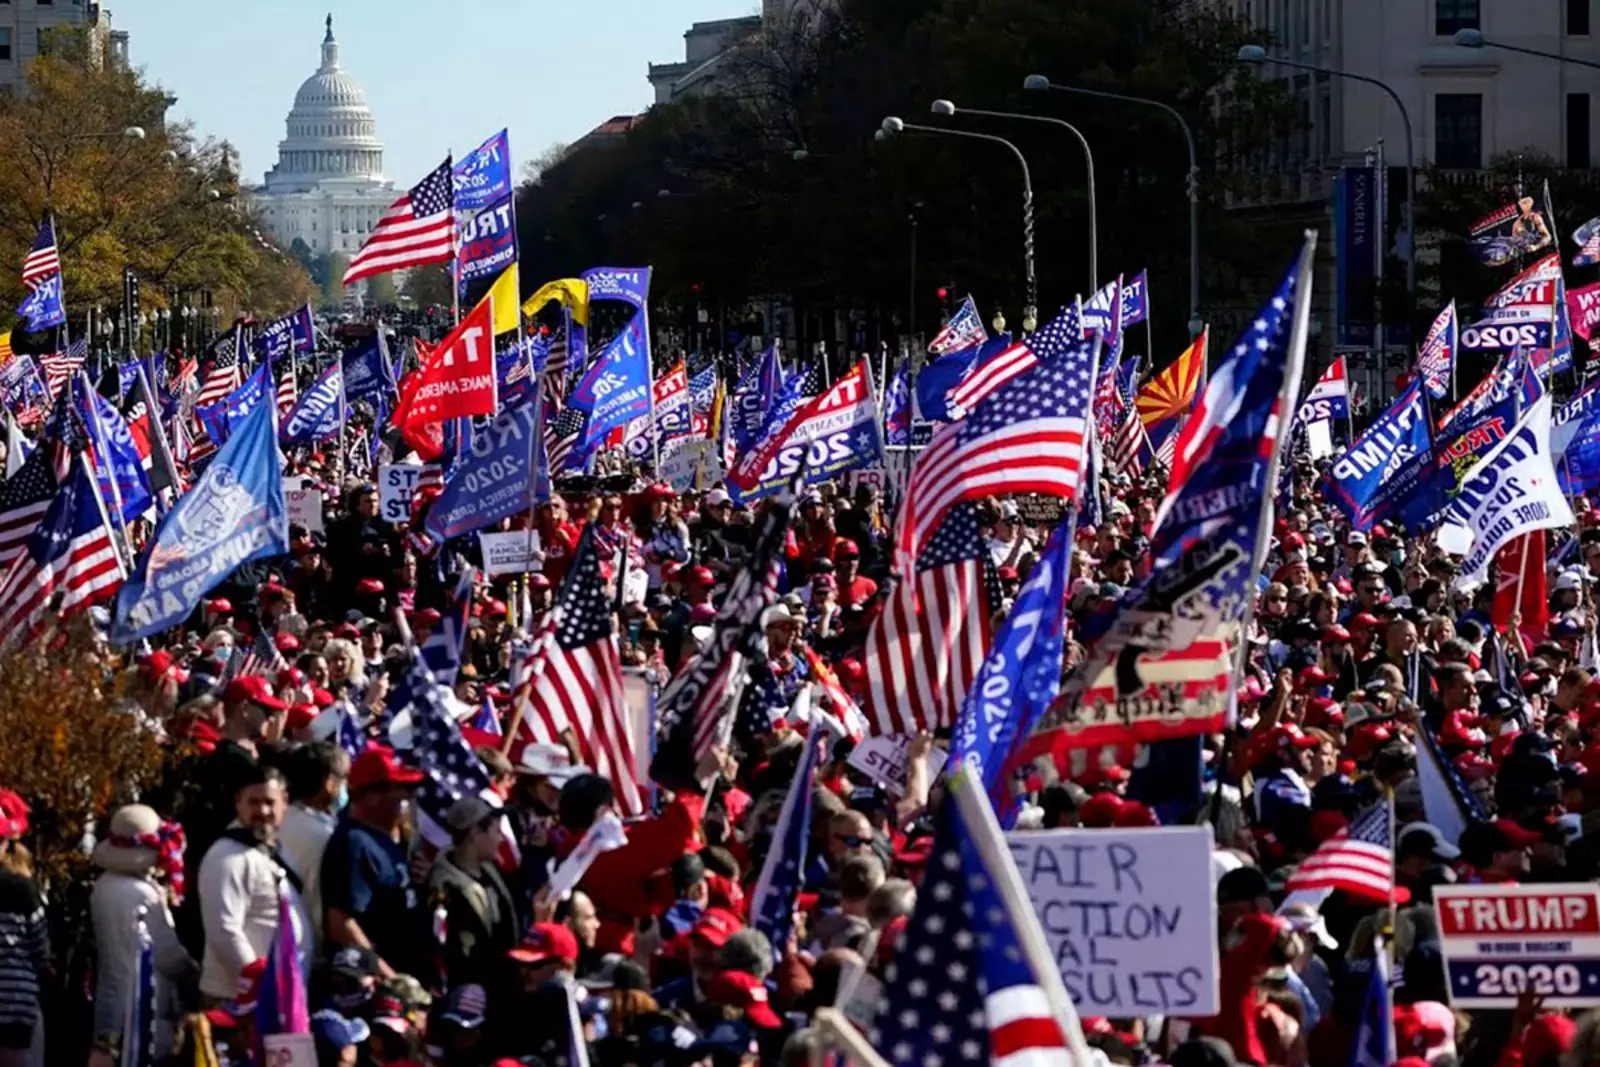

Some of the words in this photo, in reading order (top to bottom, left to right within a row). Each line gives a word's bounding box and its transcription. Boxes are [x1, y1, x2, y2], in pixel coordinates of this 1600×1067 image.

[1354, 174, 1367, 245] WEDDINGS
[1031, 897, 1182, 940] CTION
[1446, 896, 1588, 931] TRUMP
[1475, 964, 1581, 995] 2020
